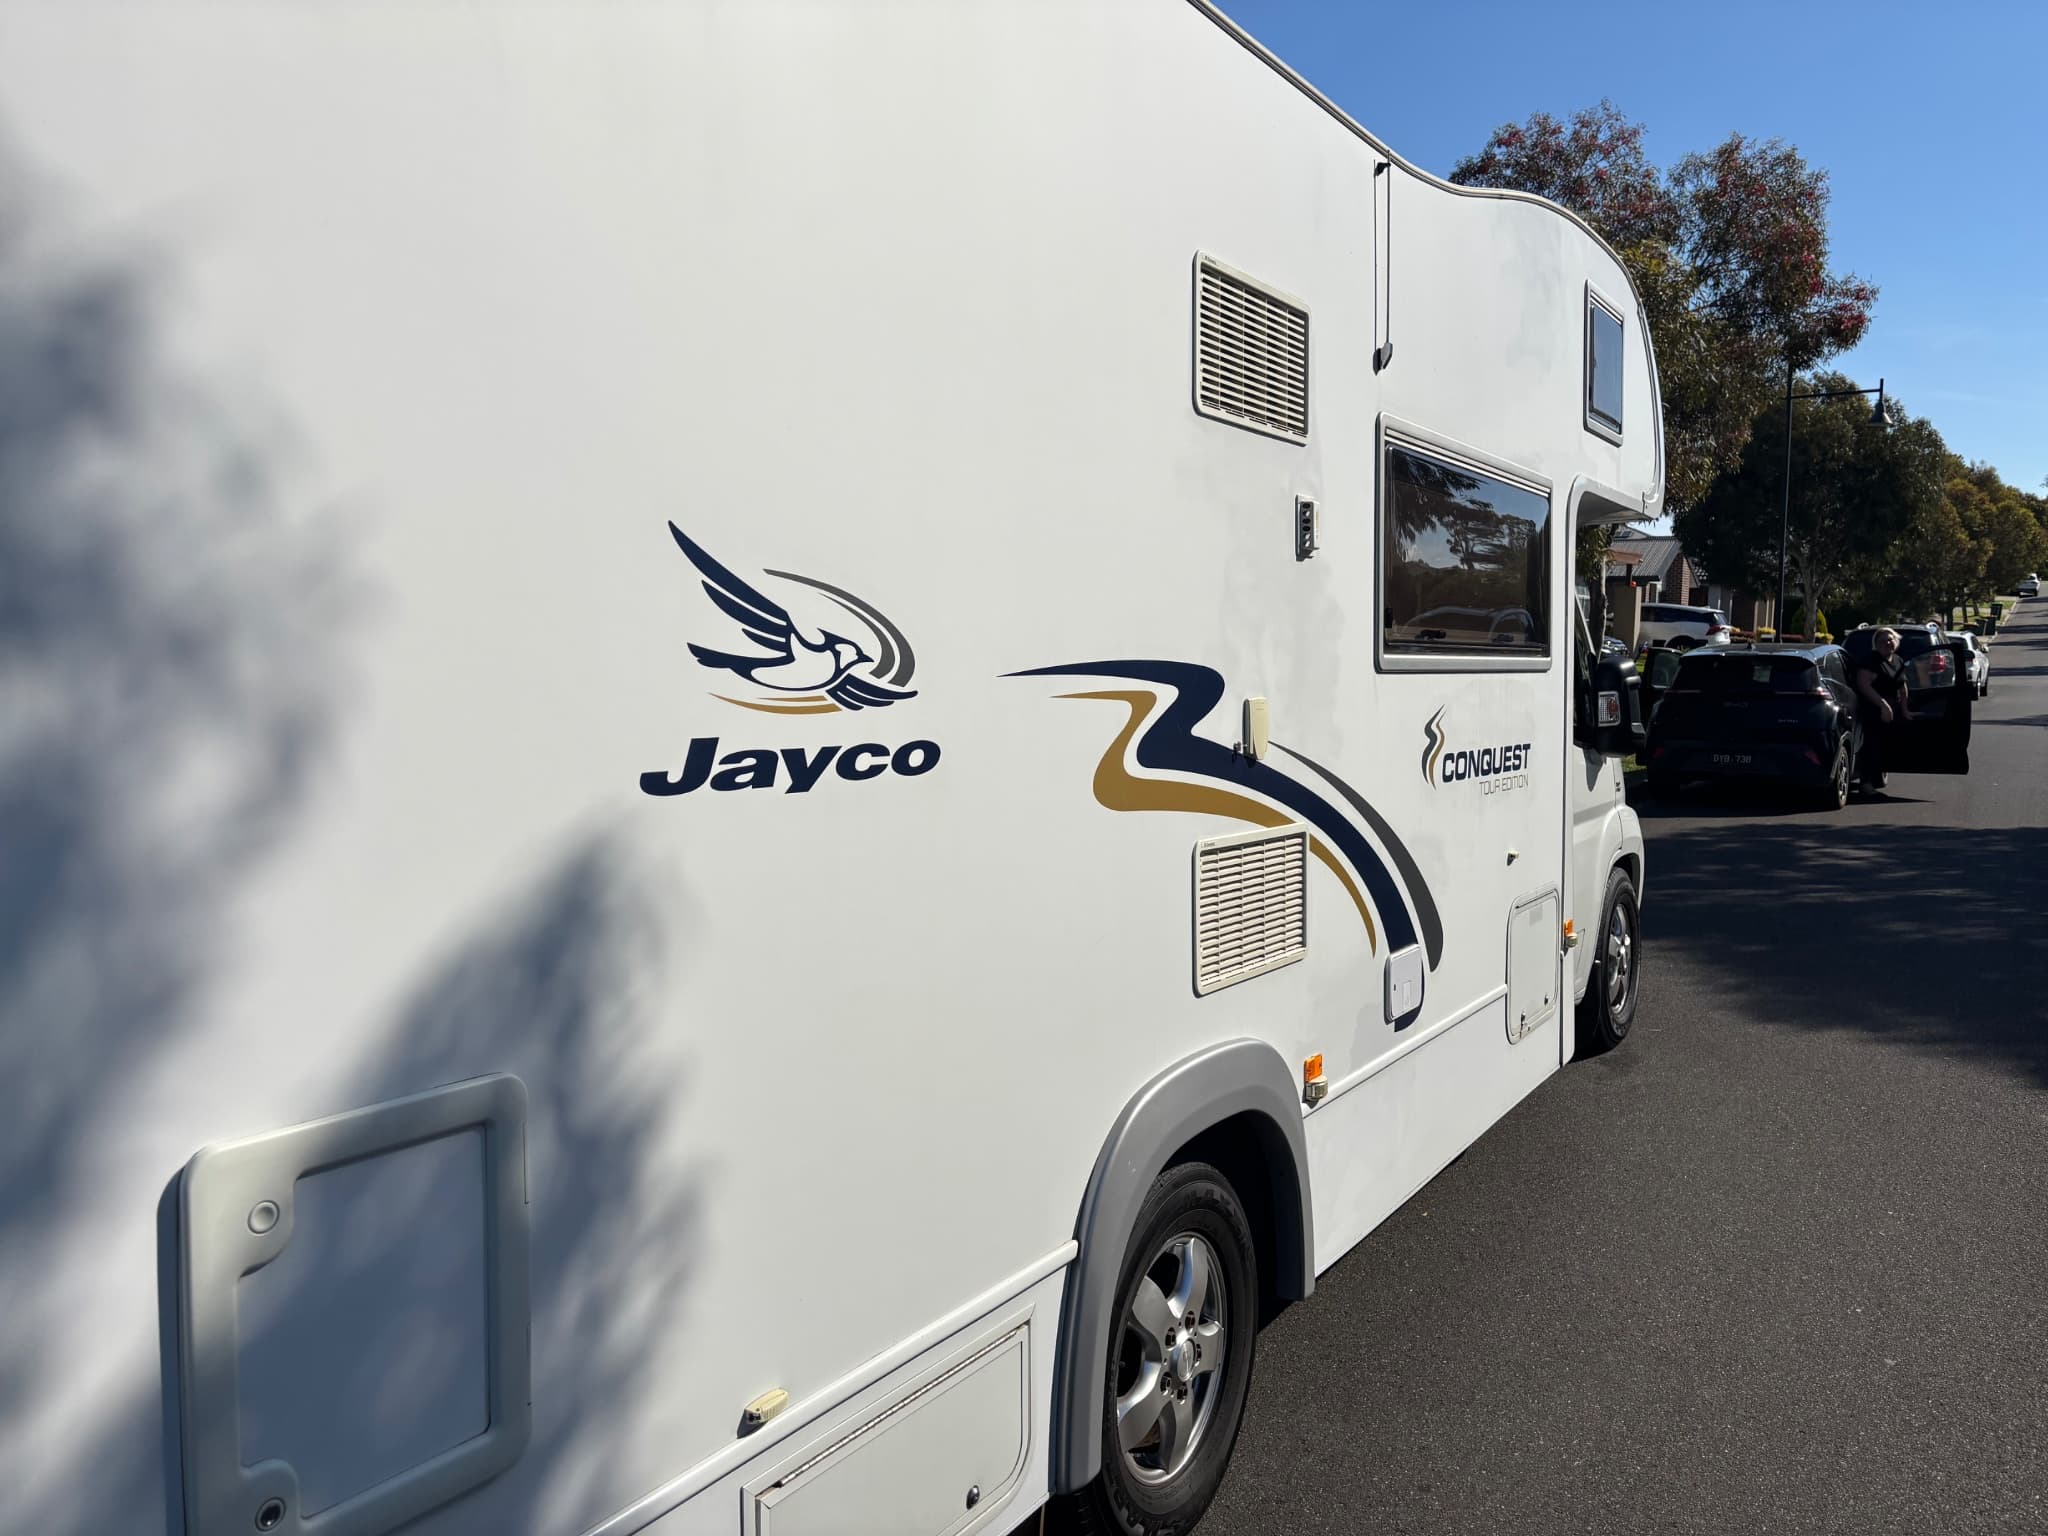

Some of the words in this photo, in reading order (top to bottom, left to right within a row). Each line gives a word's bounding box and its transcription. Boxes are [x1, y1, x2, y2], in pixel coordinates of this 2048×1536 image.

[640, 737, 941, 797] Jayco
[1442, 743, 1531, 783] CONQUEST
[1479, 779, 1500, 796] TOUR
[1501, 774, 1529, 792] EDITION
